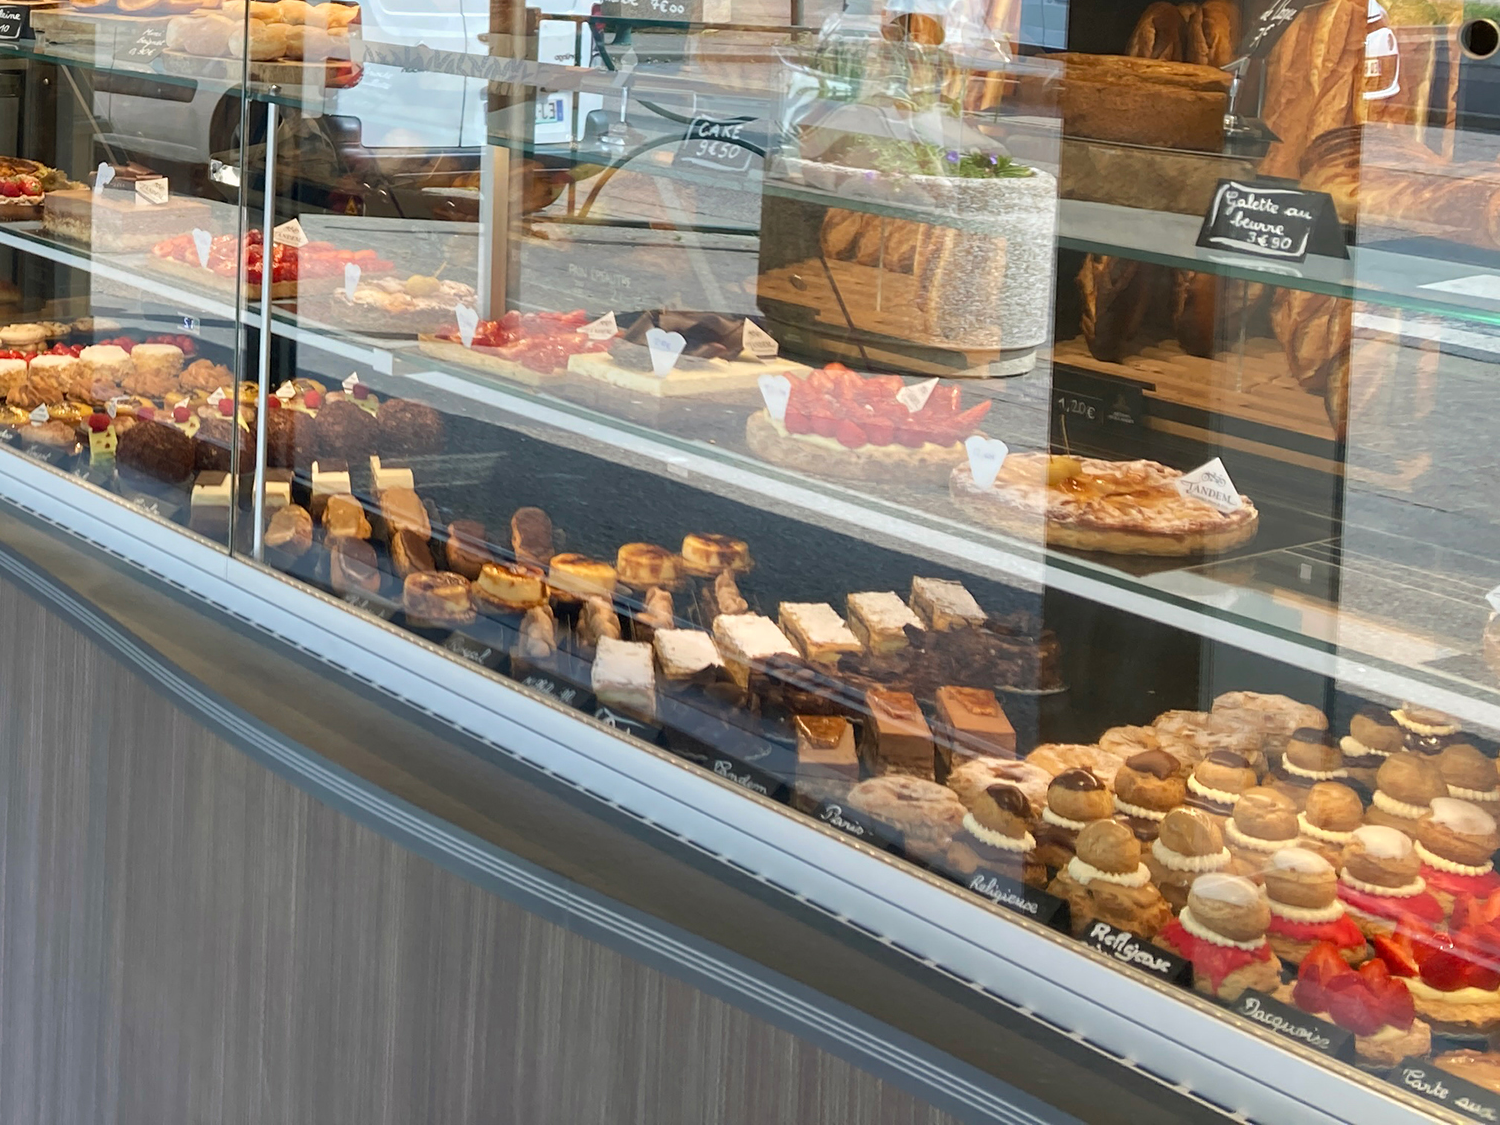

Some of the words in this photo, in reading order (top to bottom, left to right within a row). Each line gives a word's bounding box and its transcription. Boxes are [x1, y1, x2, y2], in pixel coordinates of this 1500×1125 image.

[698, 122, 745, 140] CAKE
[696, 139, 741, 159] 9€50
[1224, 190, 1280, 216] Galette
[1283, 207, 1312, 220] au
[1229, 211, 1285, 236] beurre
[1246, 231, 1293, 250] 3€90
[1181, 480, 1238, 507] TANDEM
